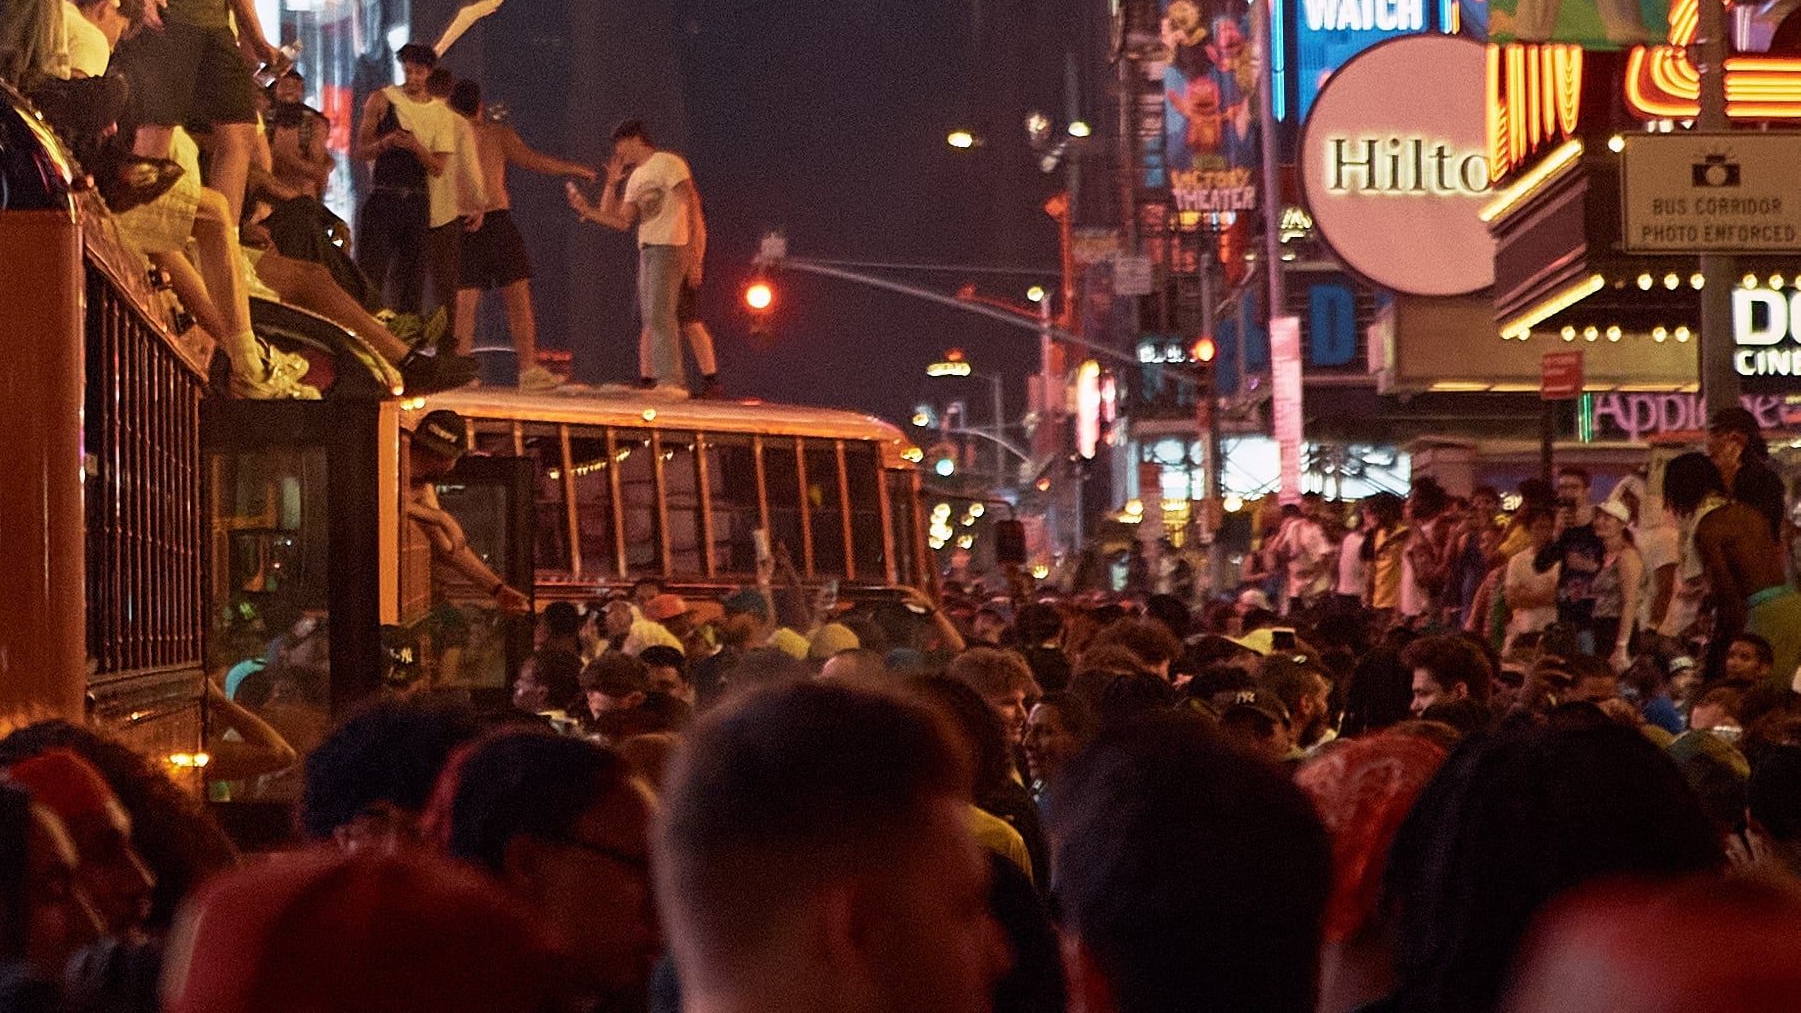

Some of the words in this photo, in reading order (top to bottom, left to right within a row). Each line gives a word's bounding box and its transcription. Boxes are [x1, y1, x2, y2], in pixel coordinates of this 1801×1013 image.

[1172, 187, 1256, 210] THEATER
[1652, 197, 1687, 215] BUS
[1695, 197, 1783, 215] CORRIDOR
[1642, 225, 1697, 242] PHOTO
[1704, 225, 1797, 243] ENFORCED
[1734, 287, 1801, 345] D
